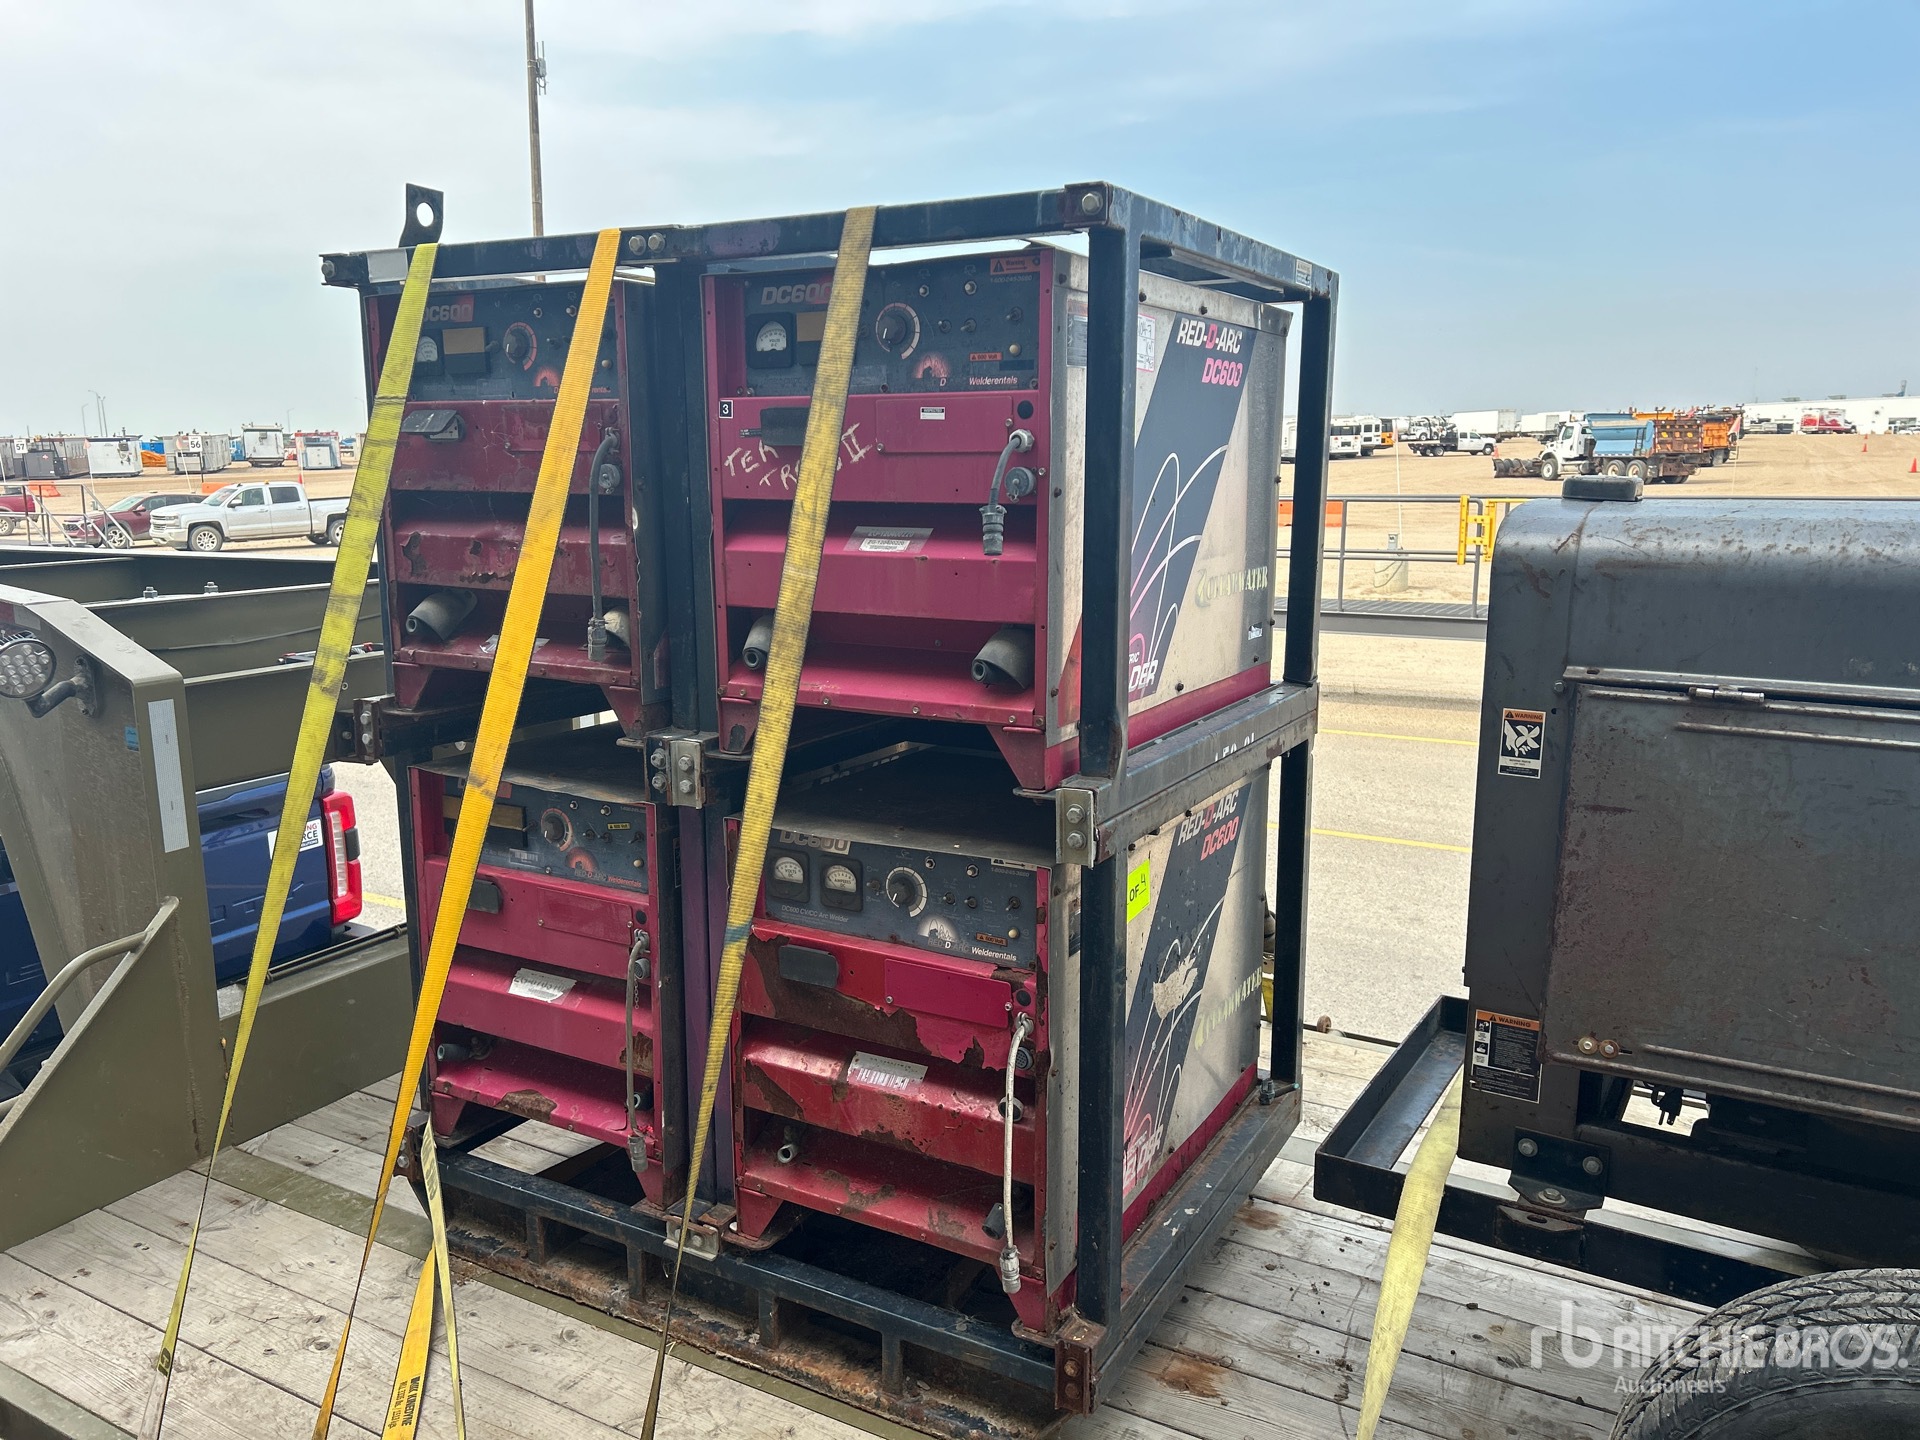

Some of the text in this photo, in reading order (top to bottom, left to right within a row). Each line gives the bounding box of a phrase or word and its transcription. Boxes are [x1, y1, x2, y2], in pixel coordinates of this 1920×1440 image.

[1176, 317, 1243, 354] RED-D-ARC
[1201, 357, 1244, 388] DC600
[969, 375, 1018, 386] Welderentals
[722, 404, 729, 415] 3
[15, 443, 25, 451] 57
[190, 440, 201, 449] 56
[1514, 712, 1544, 720] WARNING
[1177, 789, 1240, 847] RED-D-ARC
[1200, 816, 1240, 861] DC600
[971, 946, 1017, 961] Welderentals
[1498, 1016, 1531, 1028] WARNING
